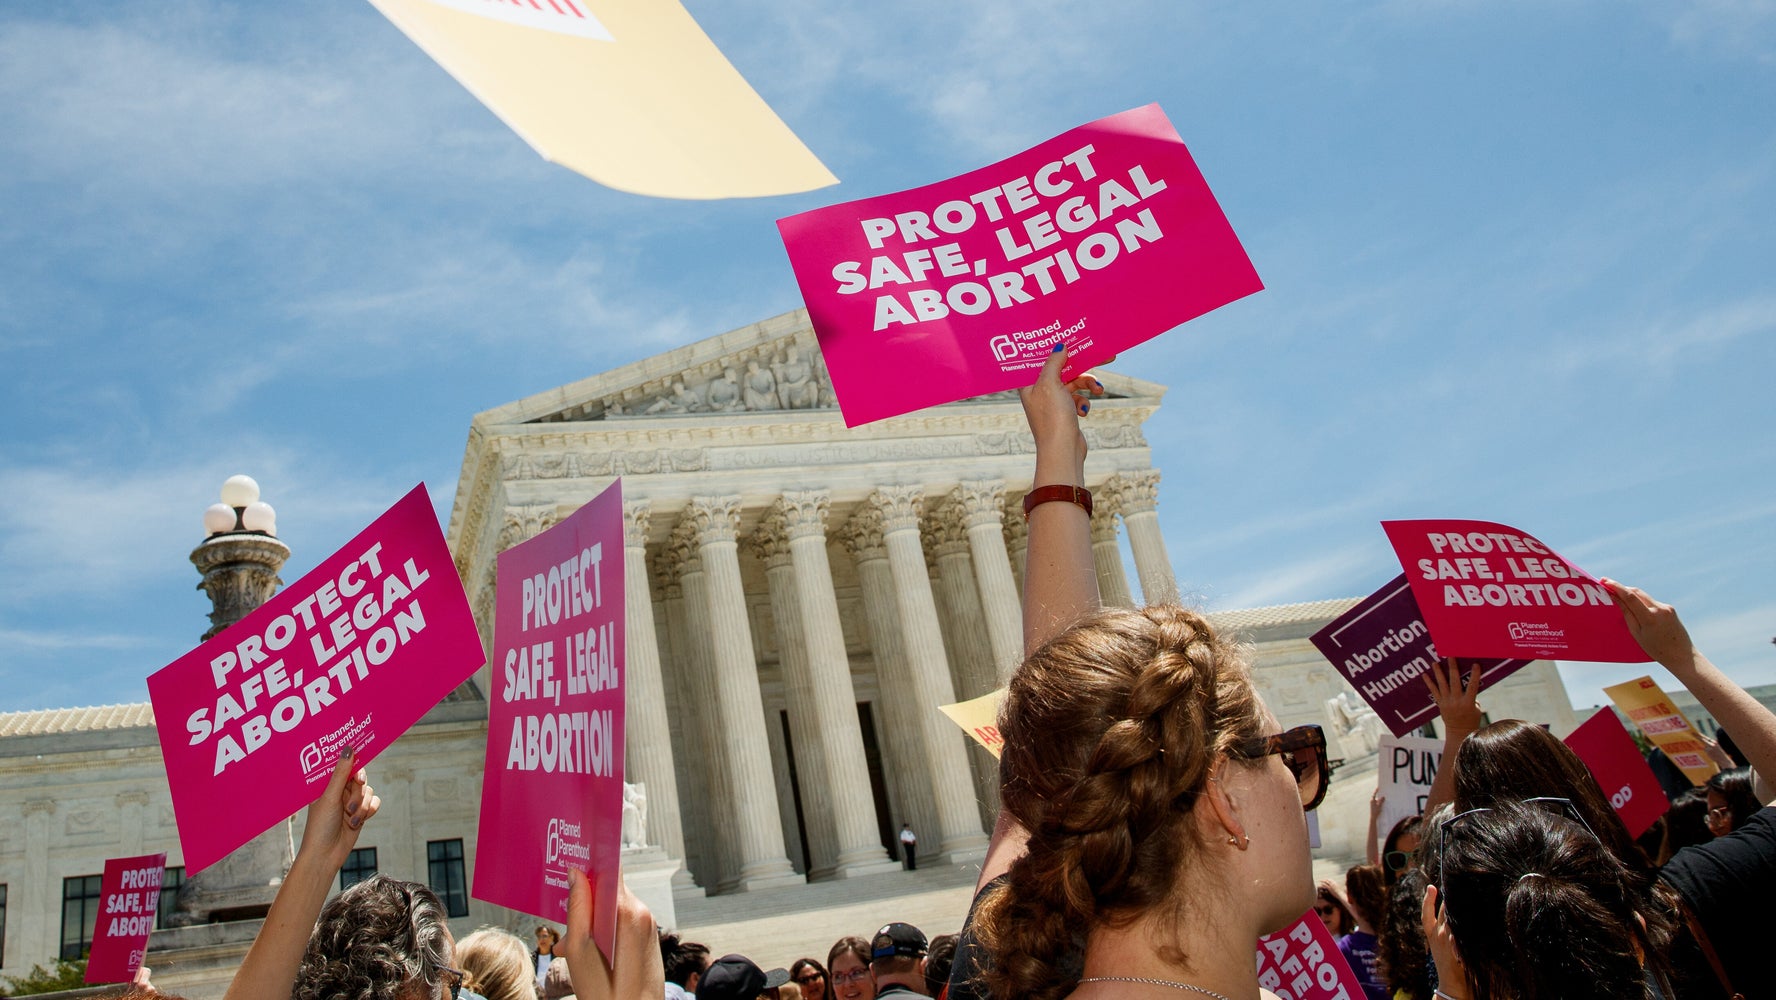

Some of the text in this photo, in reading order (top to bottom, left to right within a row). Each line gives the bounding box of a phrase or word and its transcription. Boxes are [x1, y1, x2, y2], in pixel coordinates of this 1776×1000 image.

[860, 143, 1098, 249] PROTECT
[831, 164, 1167, 295] SAFE, LEGAL
[873, 208, 1164, 332] ABORTION
[1012, 319, 1061, 342] Planned
[1017, 318, 1086, 352] Parenthood
[1079, 340, 1093, 352] Fund
[1001, 363, 1026, 372] Planned
[1427, 532, 1546, 555] PROTEC
[522, 542, 602, 632] PROTECT
[1418, 557, 1587, 582] SAFE, LEGA
[1444, 584, 1614, 606] ABORTION
[210, 541, 382, 689] PROTECT
[186, 557, 430, 745] SAFE, LEGAL
[503, 621, 618, 706] SAFE, LEGAL
[1344, 619, 1428, 678] Abortion
[214, 599, 426, 776] ABORTION
[1362, 656, 1430, 701] Human
[319, 716, 355, 747] Planned
[321, 714, 372, 756] Parenthood
[506, 709, 613, 778] ABORTION
[1393, 747, 1442, 785] PUN
[1612, 786, 1632, 808] OD
[559, 819, 581, 838] Planned
[559, 839, 590, 860] Parenthood
[106, 893, 142, 914] SAFE,
[107, 916, 152, 937] ABORT
[1289, 921, 1351, 1000] PROT
